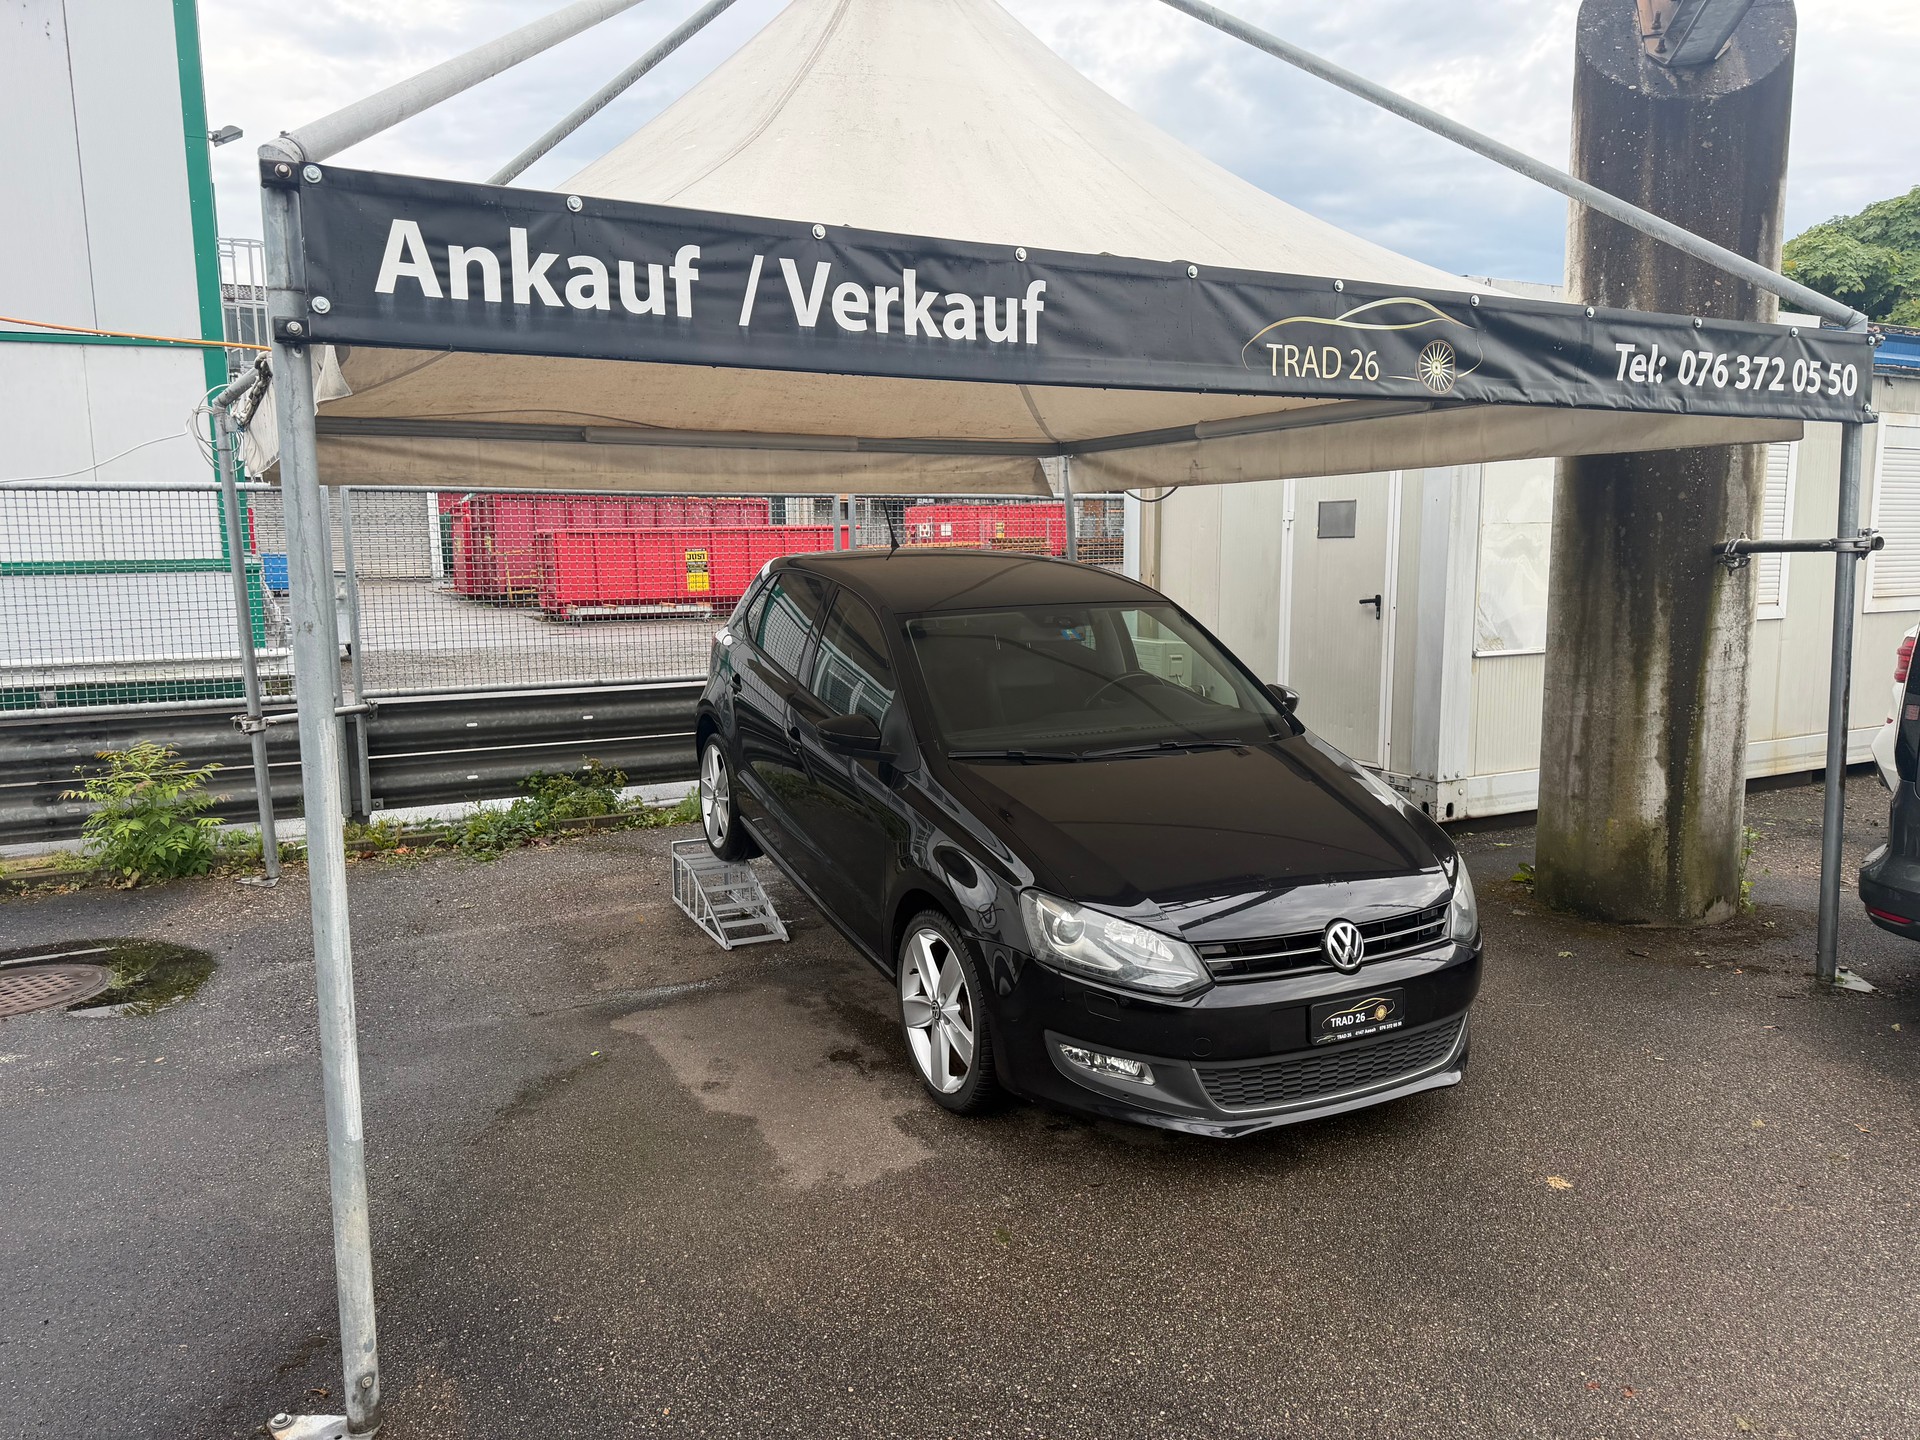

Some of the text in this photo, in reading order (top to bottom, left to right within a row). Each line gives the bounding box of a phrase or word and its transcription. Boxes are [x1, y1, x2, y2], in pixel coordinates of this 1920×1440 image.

[375, 218, 700, 318] Ankauf
[1266, 342, 1380, 381] TRAD 26
[1615, 342, 1858, 397] Tel: 076 372 05 50
[1330, 1012, 1366, 1028] TRAD 26
